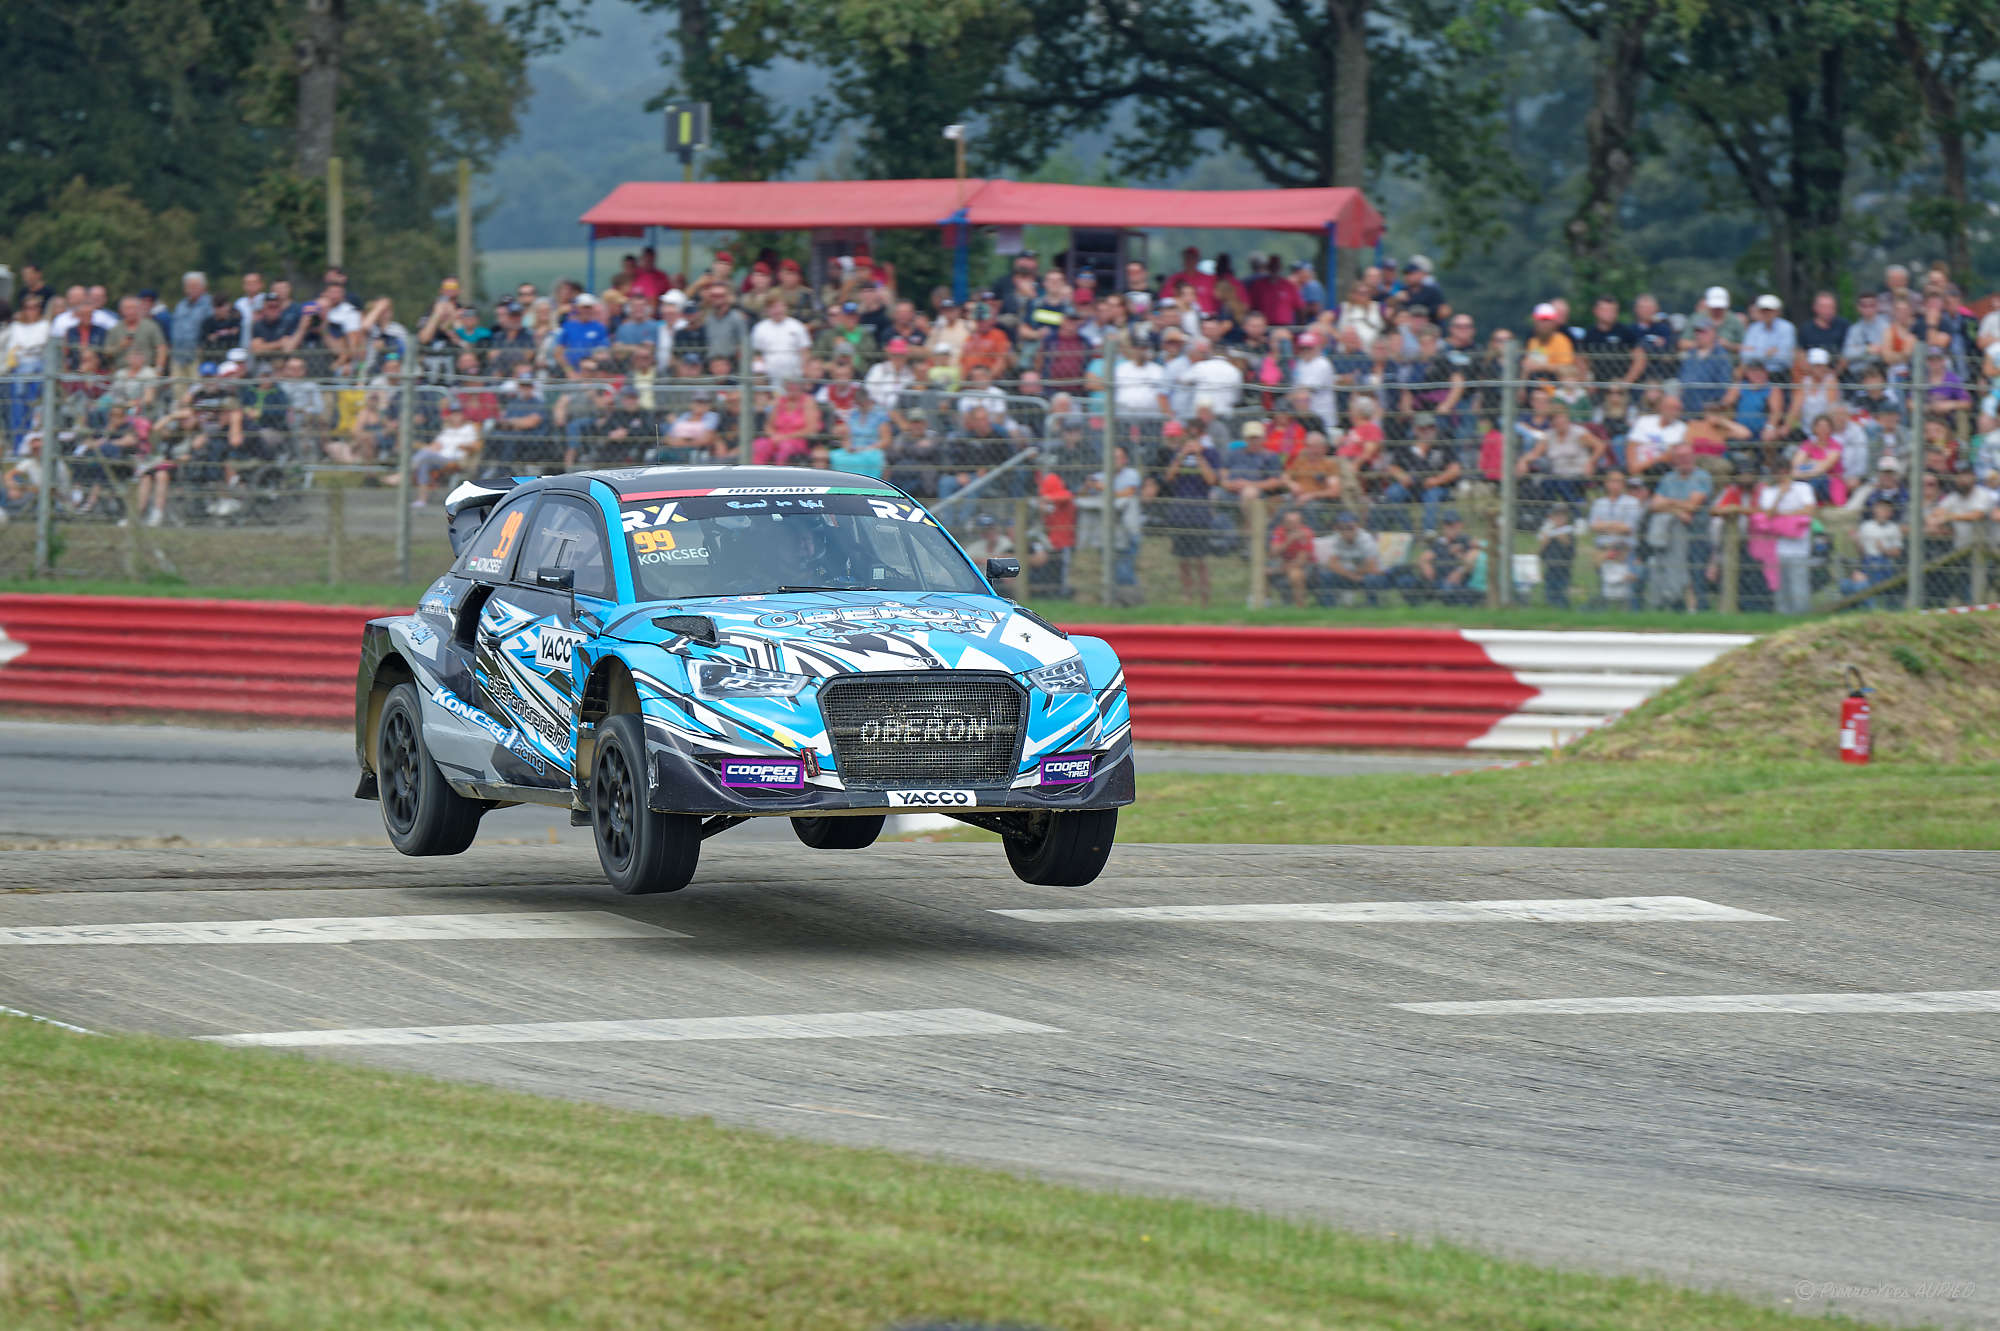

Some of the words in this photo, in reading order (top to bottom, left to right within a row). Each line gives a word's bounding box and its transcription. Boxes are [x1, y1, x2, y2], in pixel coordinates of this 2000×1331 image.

[621, 502, 688, 532] RX
[868, 499, 938, 528] RX
[492, 510, 524, 559] 99
[633, 529, 676, 554] 99
[638, 548, 709, 566] KONCSEG
[754, 605, 1001, 629] OBERON
[860, 716, 988, 744] OBERON
[726, 764, 798, 776] COOPER
[1045, 760, 1090, 772] COOPER
[1067, 769, 1089, 778] TIRES
[760, 774, 796, 784] TIRES
[897, 791, 968, 805] YACCO
